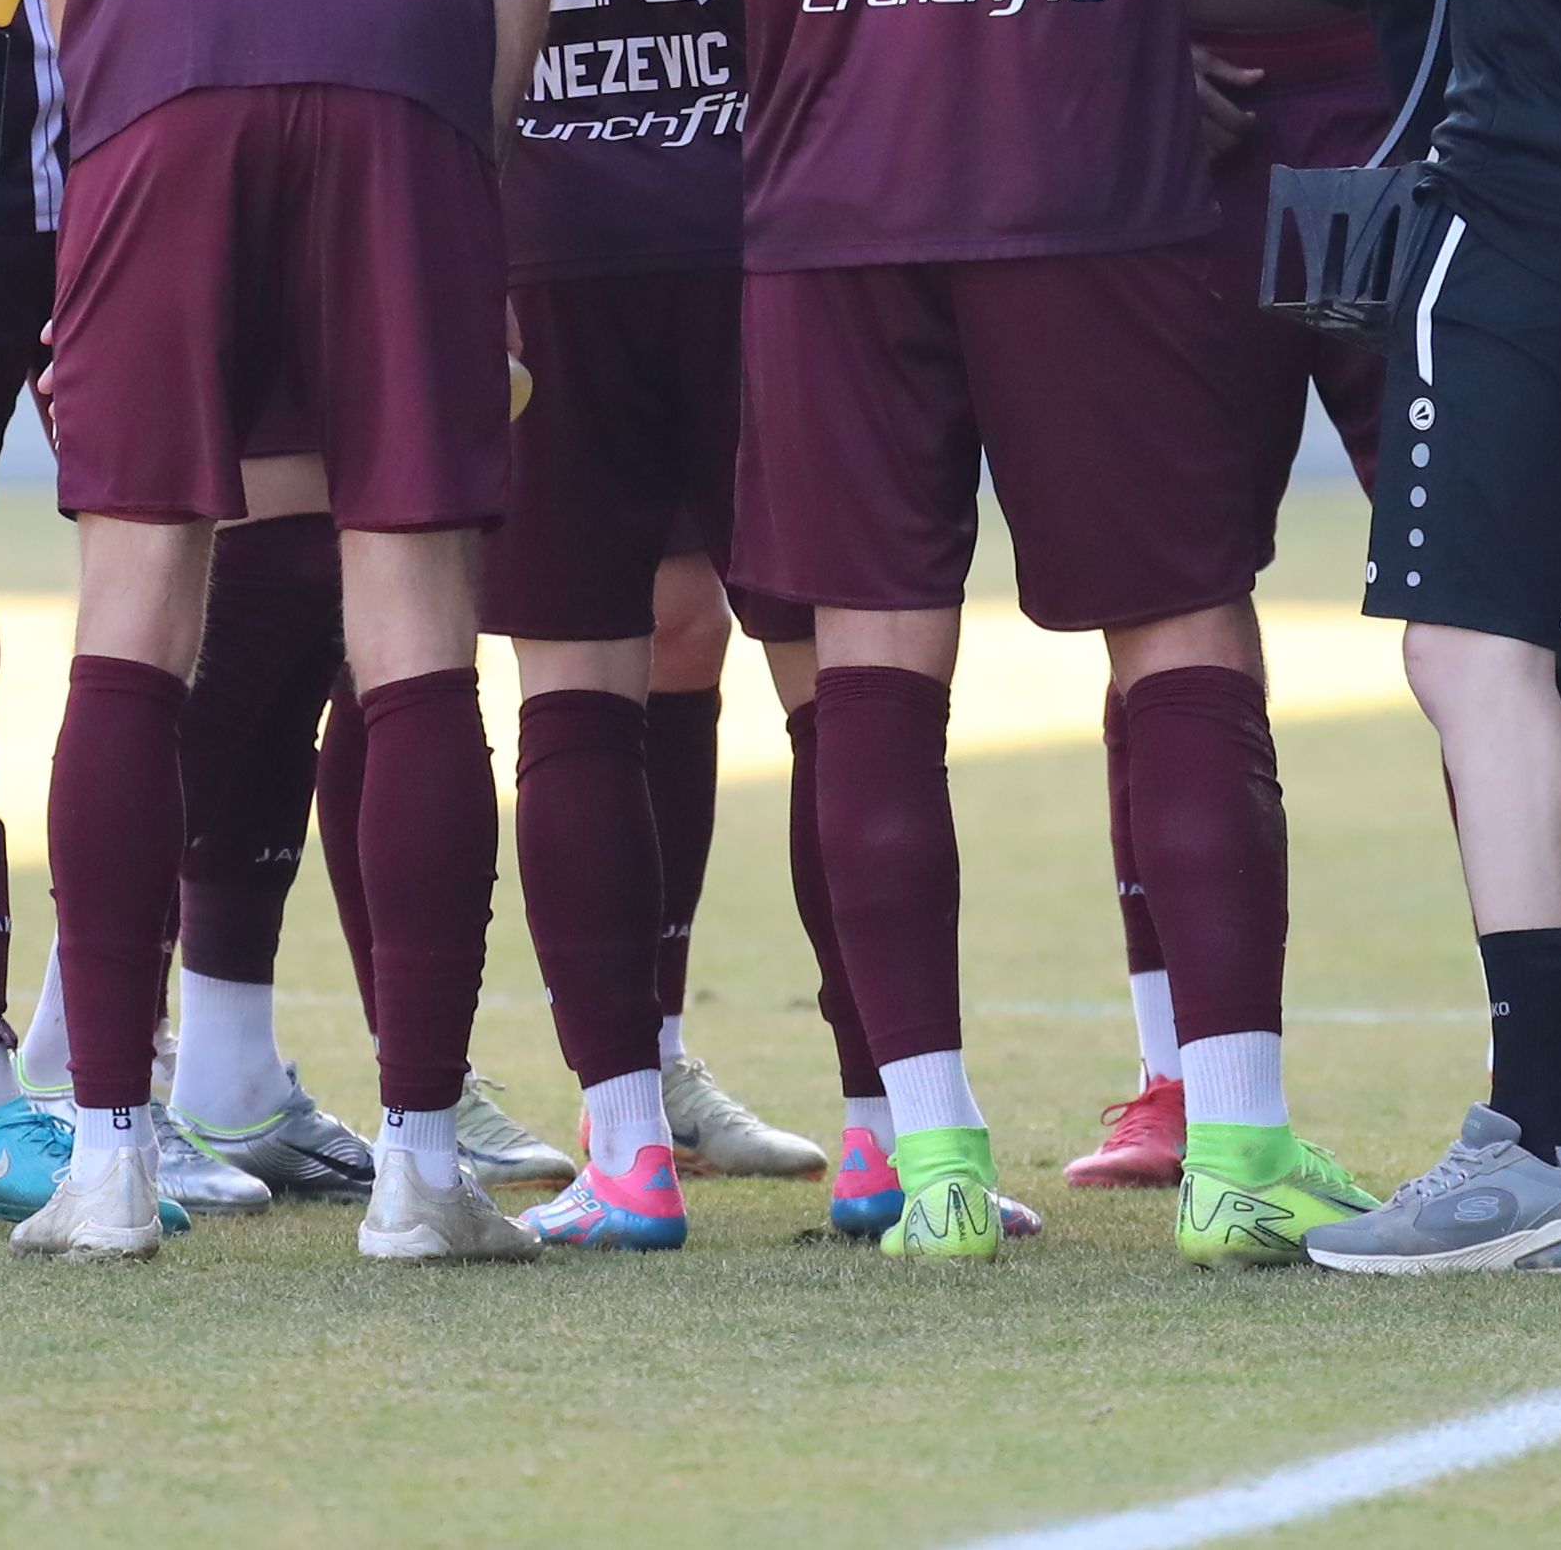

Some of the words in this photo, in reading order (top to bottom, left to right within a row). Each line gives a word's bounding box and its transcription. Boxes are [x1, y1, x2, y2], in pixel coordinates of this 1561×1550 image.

[524, 31, 731, 102] NEZEVIC
[516, 91, 750, 148] unchfit
[254, 846, 302, 864] JA
[1492, 1001, 1511, 1017] KO
